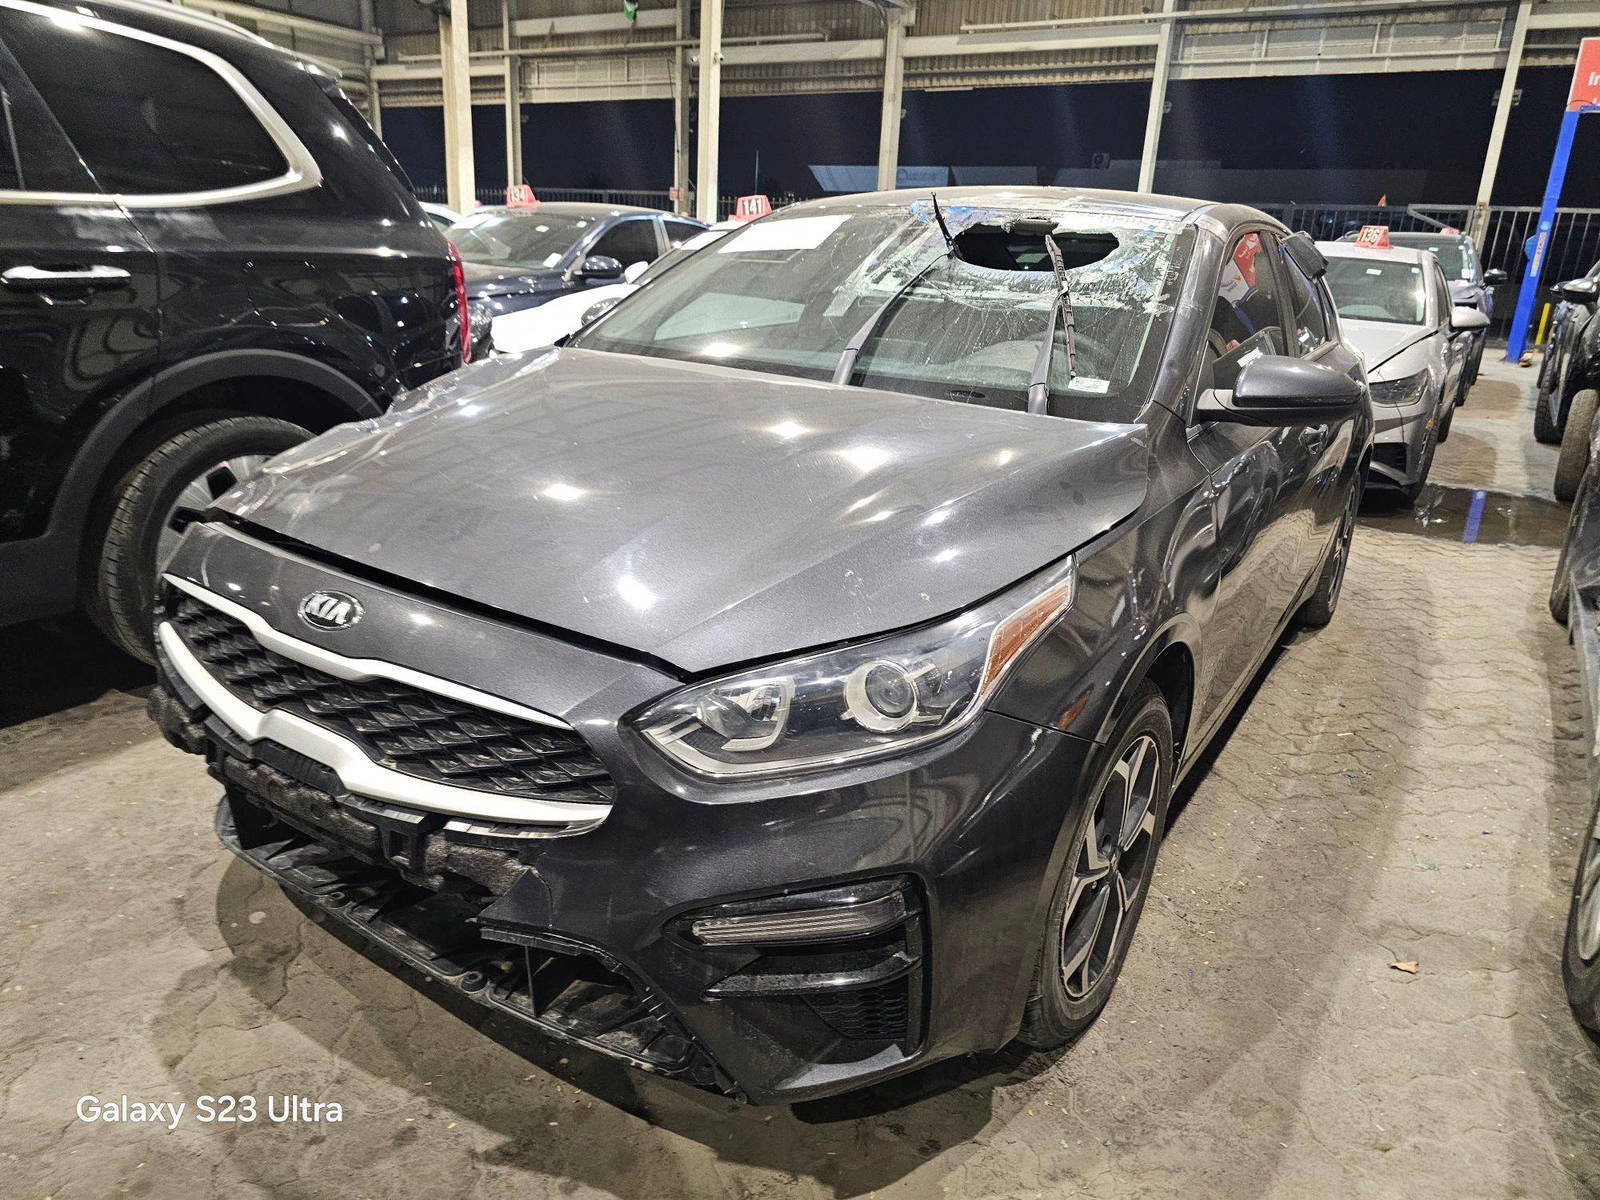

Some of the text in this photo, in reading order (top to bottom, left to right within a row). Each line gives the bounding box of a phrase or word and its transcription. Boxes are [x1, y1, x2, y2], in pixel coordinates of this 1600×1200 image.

[743, 197, 764, 216] 141
[1360, 227, 1379, 243] 136
[304, 593, 352, 624] KIA
